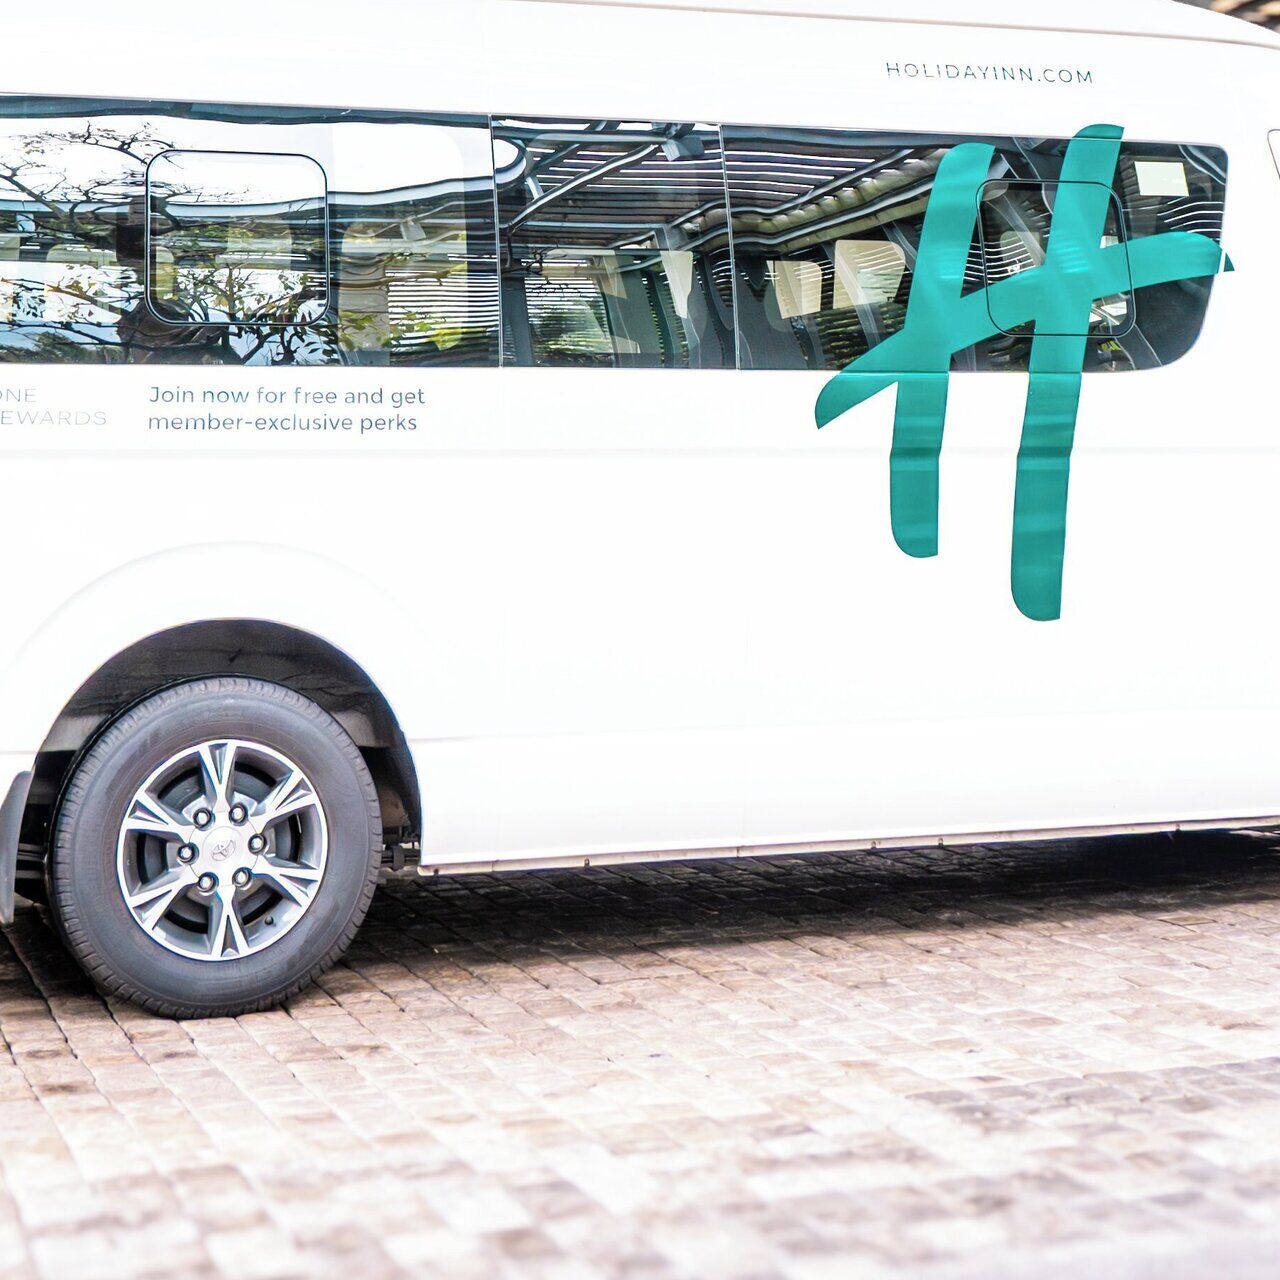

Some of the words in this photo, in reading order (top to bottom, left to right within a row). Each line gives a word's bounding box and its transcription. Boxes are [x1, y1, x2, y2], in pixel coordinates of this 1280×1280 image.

[885, 62, 1094, 84] HOLIDAYINN.COM
[149, 386, 195, 404] Join
[202, 389, 250, 404] now
[257, 386, 287, 405] for
[294, 386, 338, 405] free
[345, 388, 384, 405] and
[391, 388, 426, 409] get
[148, 412, 353, 432] member-exclusive
[360, 413, 418, 435] perks
